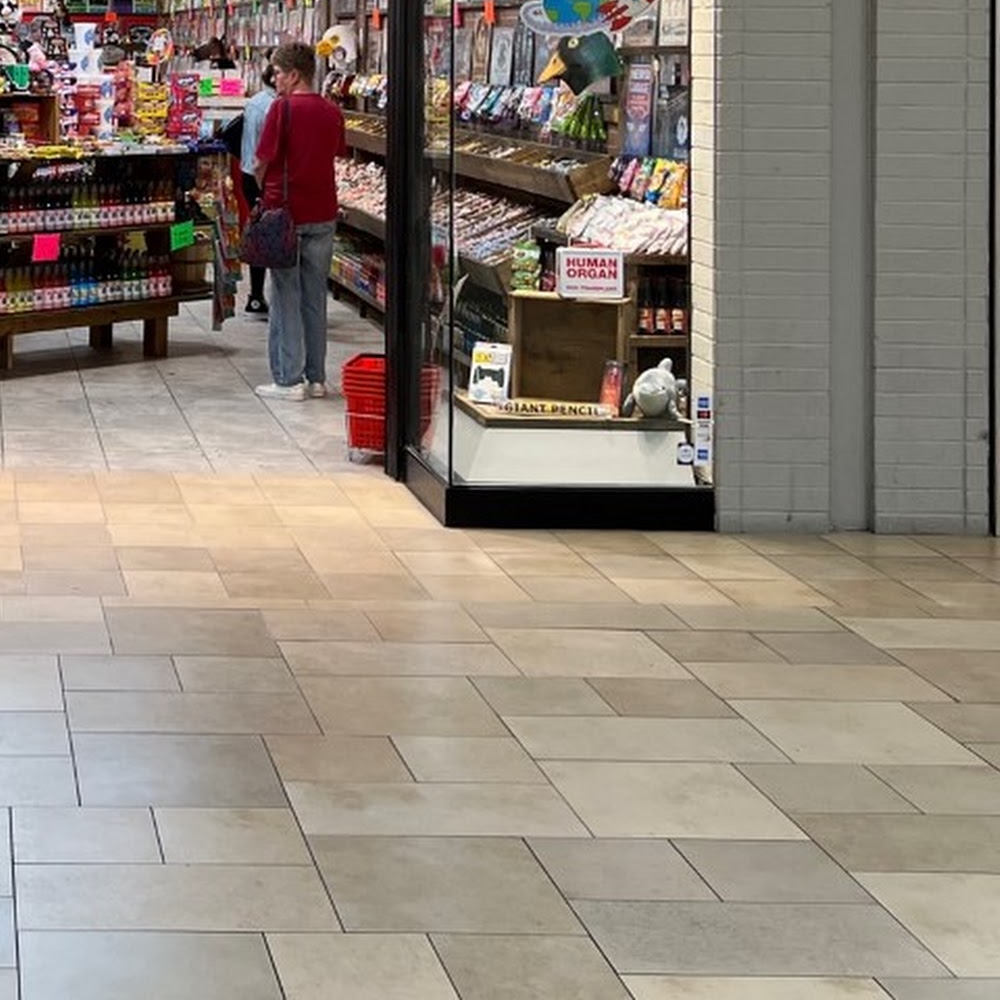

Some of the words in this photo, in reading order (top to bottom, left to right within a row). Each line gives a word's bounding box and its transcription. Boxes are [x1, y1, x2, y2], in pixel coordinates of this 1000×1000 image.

[566, 257, 617, 268] HUMAN
[566, 268, 617, 279] ORGAN
[504, 403, 547, 414] GIANT
